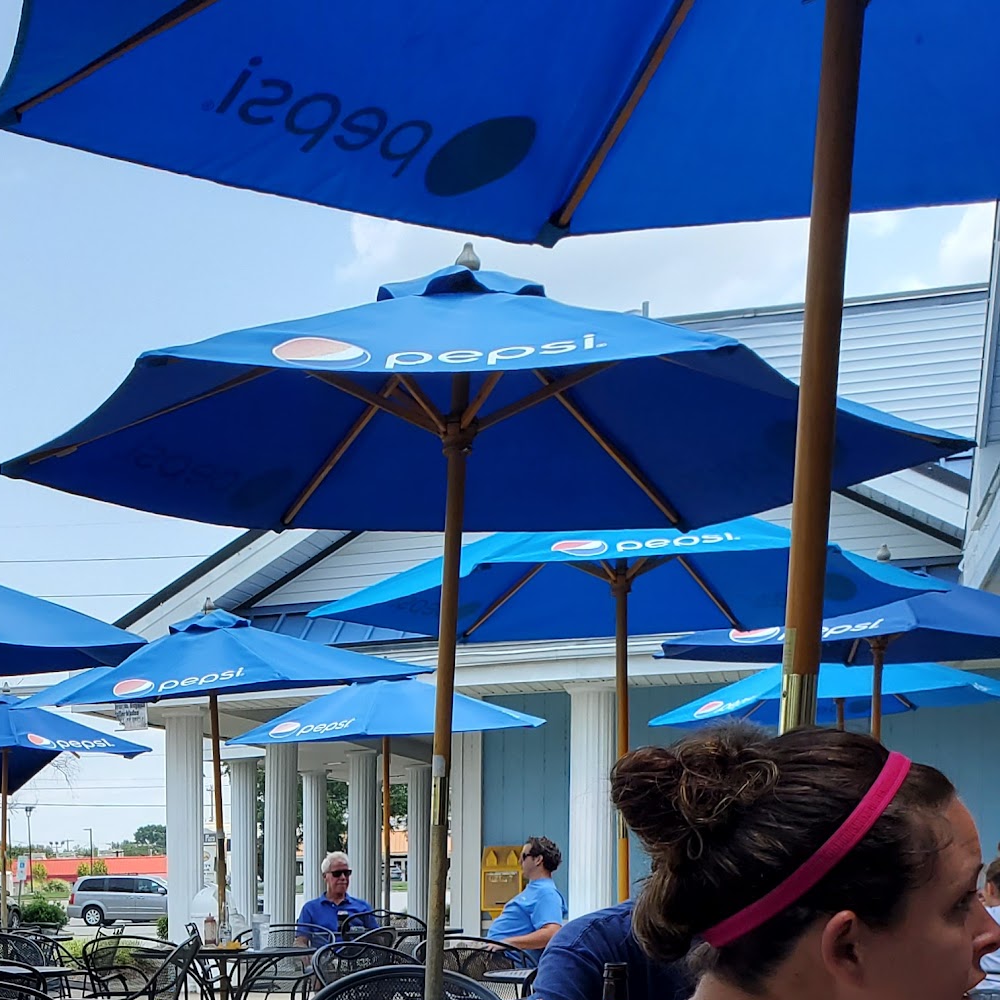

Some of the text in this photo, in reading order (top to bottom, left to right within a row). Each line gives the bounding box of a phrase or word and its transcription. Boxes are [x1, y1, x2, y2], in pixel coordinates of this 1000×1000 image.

[384, 333, 602, 370] pepsi
[616, 532, 737, 553] pepsi
[157, 667, 244, 693] pepsi
[295, 717, 356, 737] pepsi
[56, 738, 113, 750] pepsi
